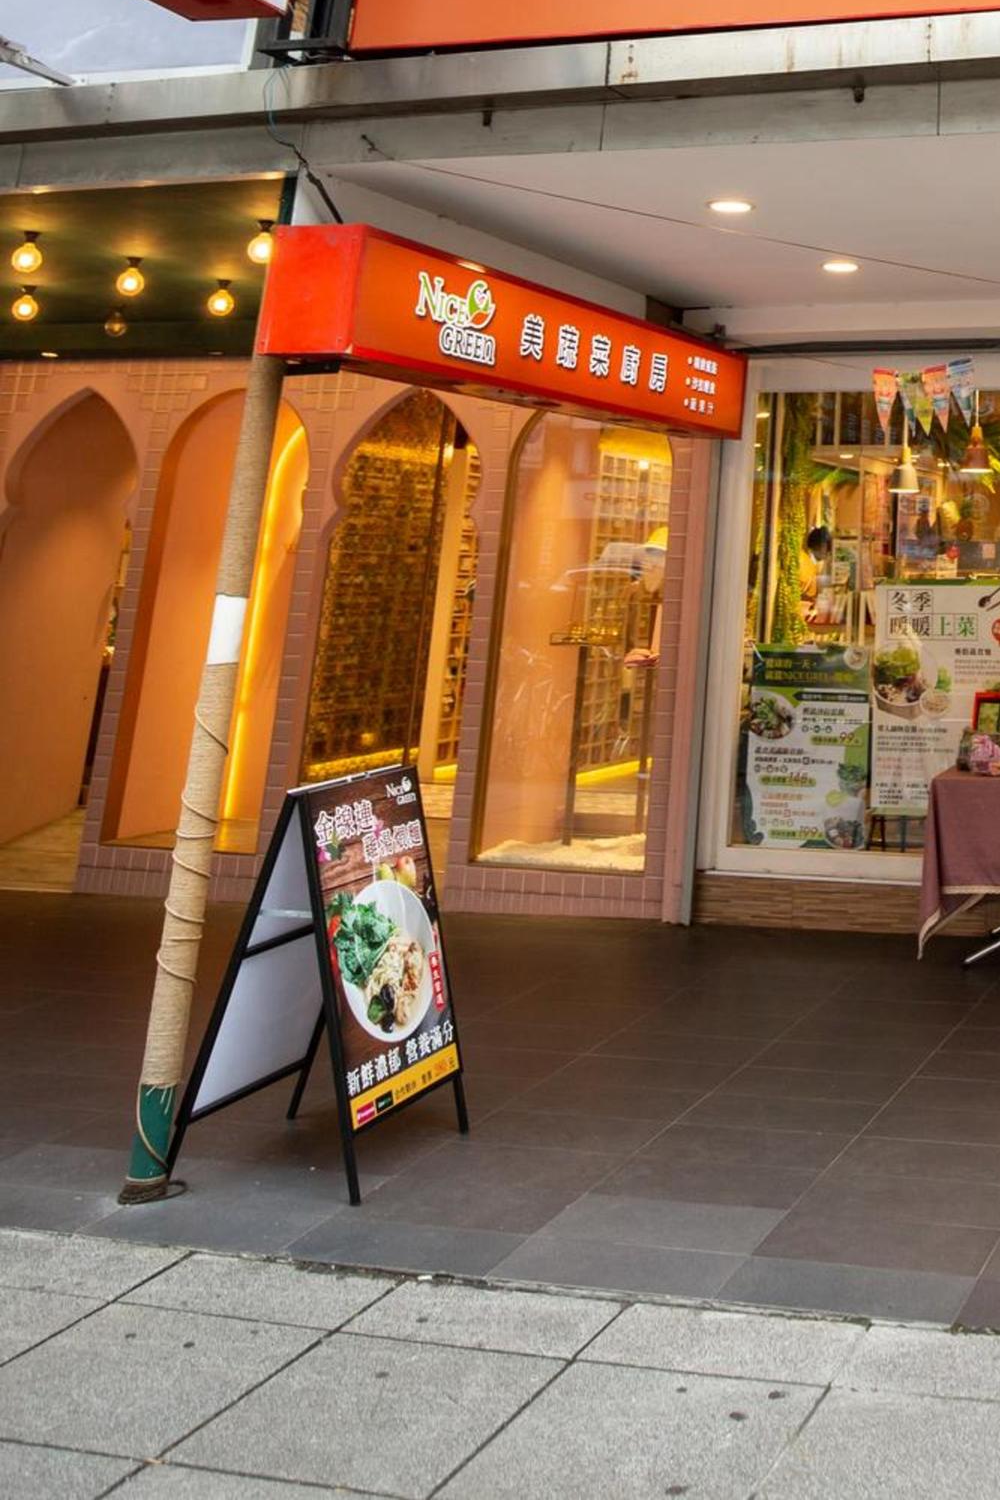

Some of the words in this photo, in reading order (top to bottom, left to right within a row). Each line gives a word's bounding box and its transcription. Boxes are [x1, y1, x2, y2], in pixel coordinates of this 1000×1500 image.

[415, 272, 467, 321] NICE
[519, 314, 669, 393] 美蔬菜廚房
[892, 591, 931, 612] 冬季
[890, 615, 975, 637] 暖暖上菜
